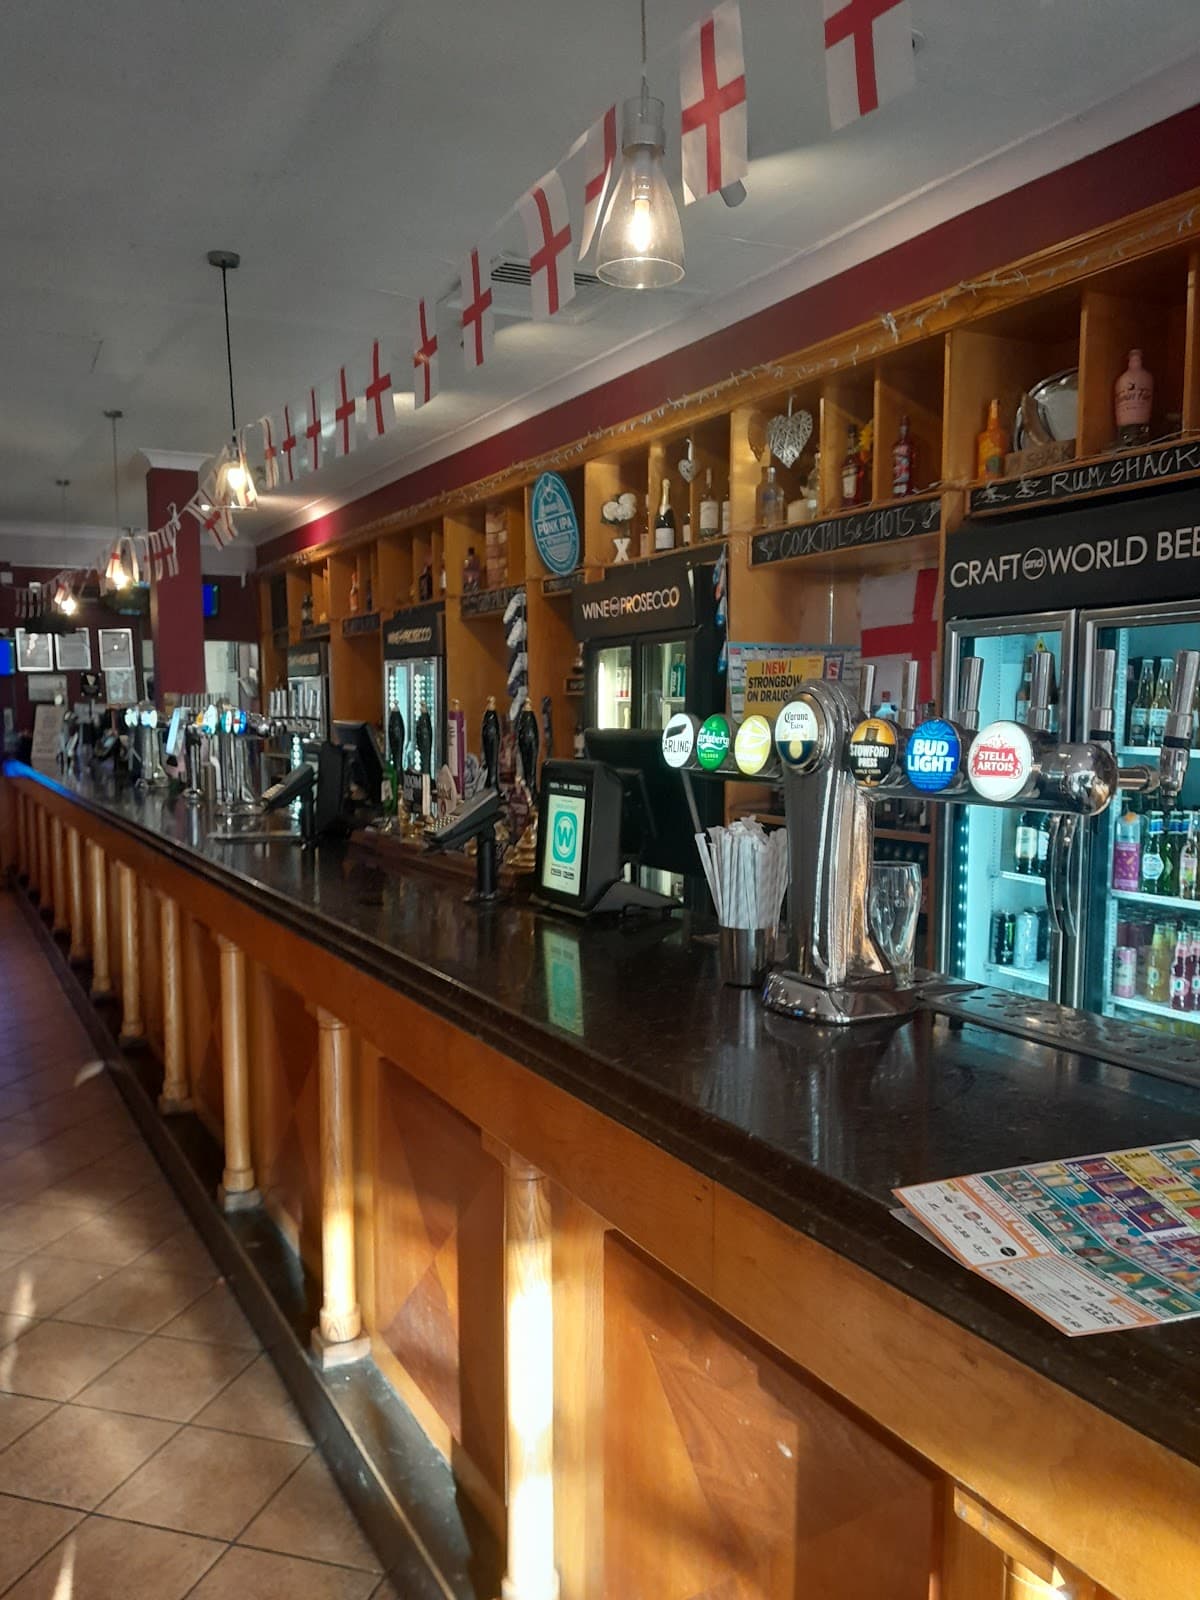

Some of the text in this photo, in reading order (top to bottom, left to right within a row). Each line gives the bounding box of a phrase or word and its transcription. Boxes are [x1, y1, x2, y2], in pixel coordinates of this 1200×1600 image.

[1051, 447, 1200, 495] RUM SHACK
[537, 516, 573, 535] PUNK IPA
[780, 518, 855, 558] COCKTAILS
[863, 508, 916, 543] SHOTS
[950, 553, 1021, 588] CRAFT
[1048, 536, 1148, 575] WORLD
[582, 600, 609, 619] WINE
[620, 586, 680, 615] PROSECCO
[748, 674, 803, 689] STRONGBOW
[747, 689, 791, 701] ON DRAUG
[784, 711, 808, 723] Corona
[662, 739, 689, 753] ARLING
[850, 744, 890, 758] STOWFORD
[912, 739, 949, 756] BUD
[858, 758, 878, 768] PRESS
[907, 755, 955, 772] LIGHT
[978, 751, 1014, 761] STELLA
[977, 761, 1014, 772] ARTOIS
[557, 825, 573, 848] W
